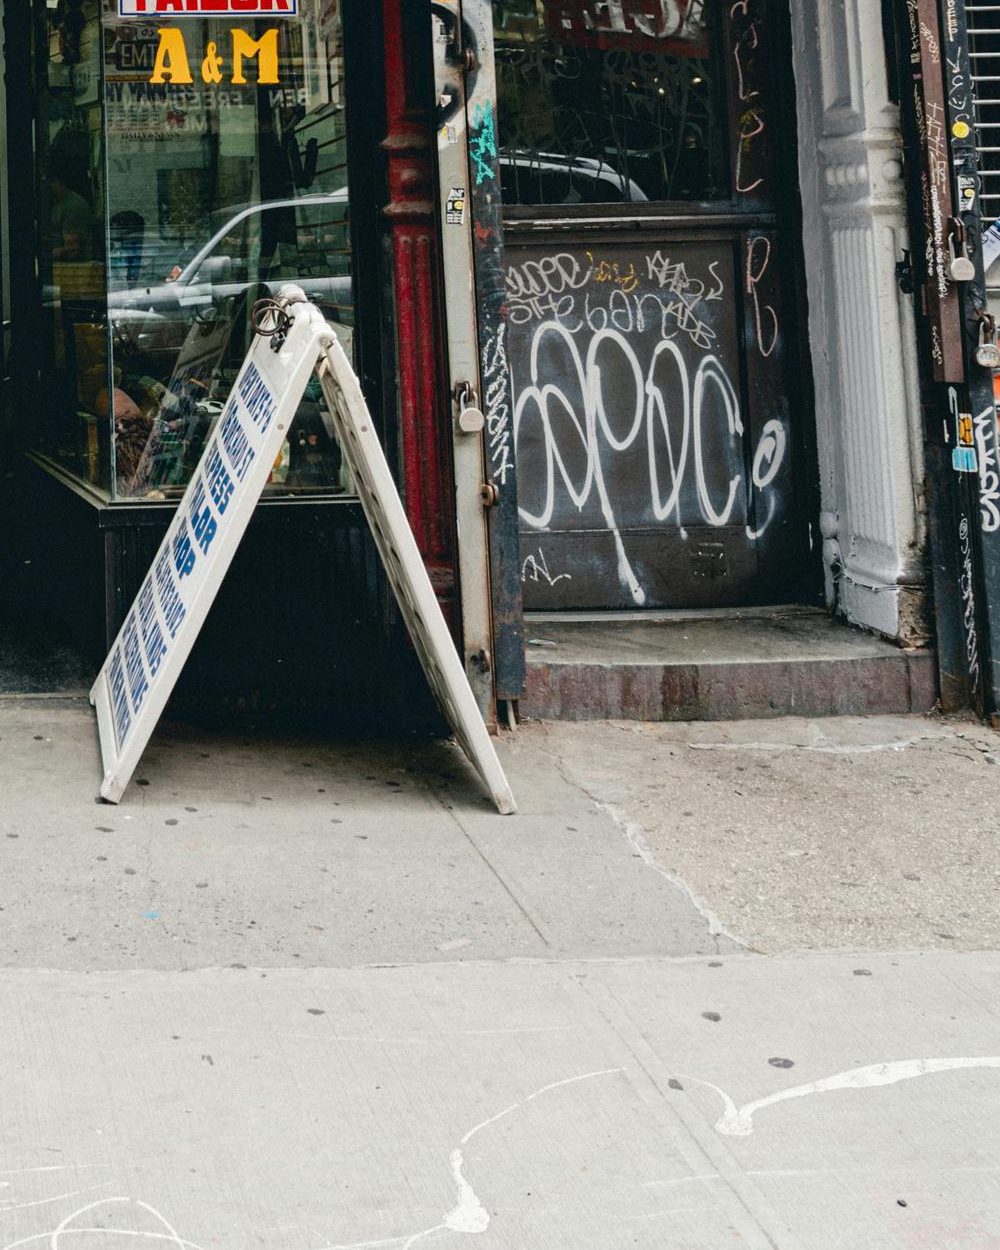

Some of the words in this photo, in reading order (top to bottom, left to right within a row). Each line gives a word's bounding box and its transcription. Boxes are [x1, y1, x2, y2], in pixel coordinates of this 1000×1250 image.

[190, 474, 217, 555] TAILOR
[205, 439, 234, 515] EXPRESS
[173, 517, 196, 580] SHOP
